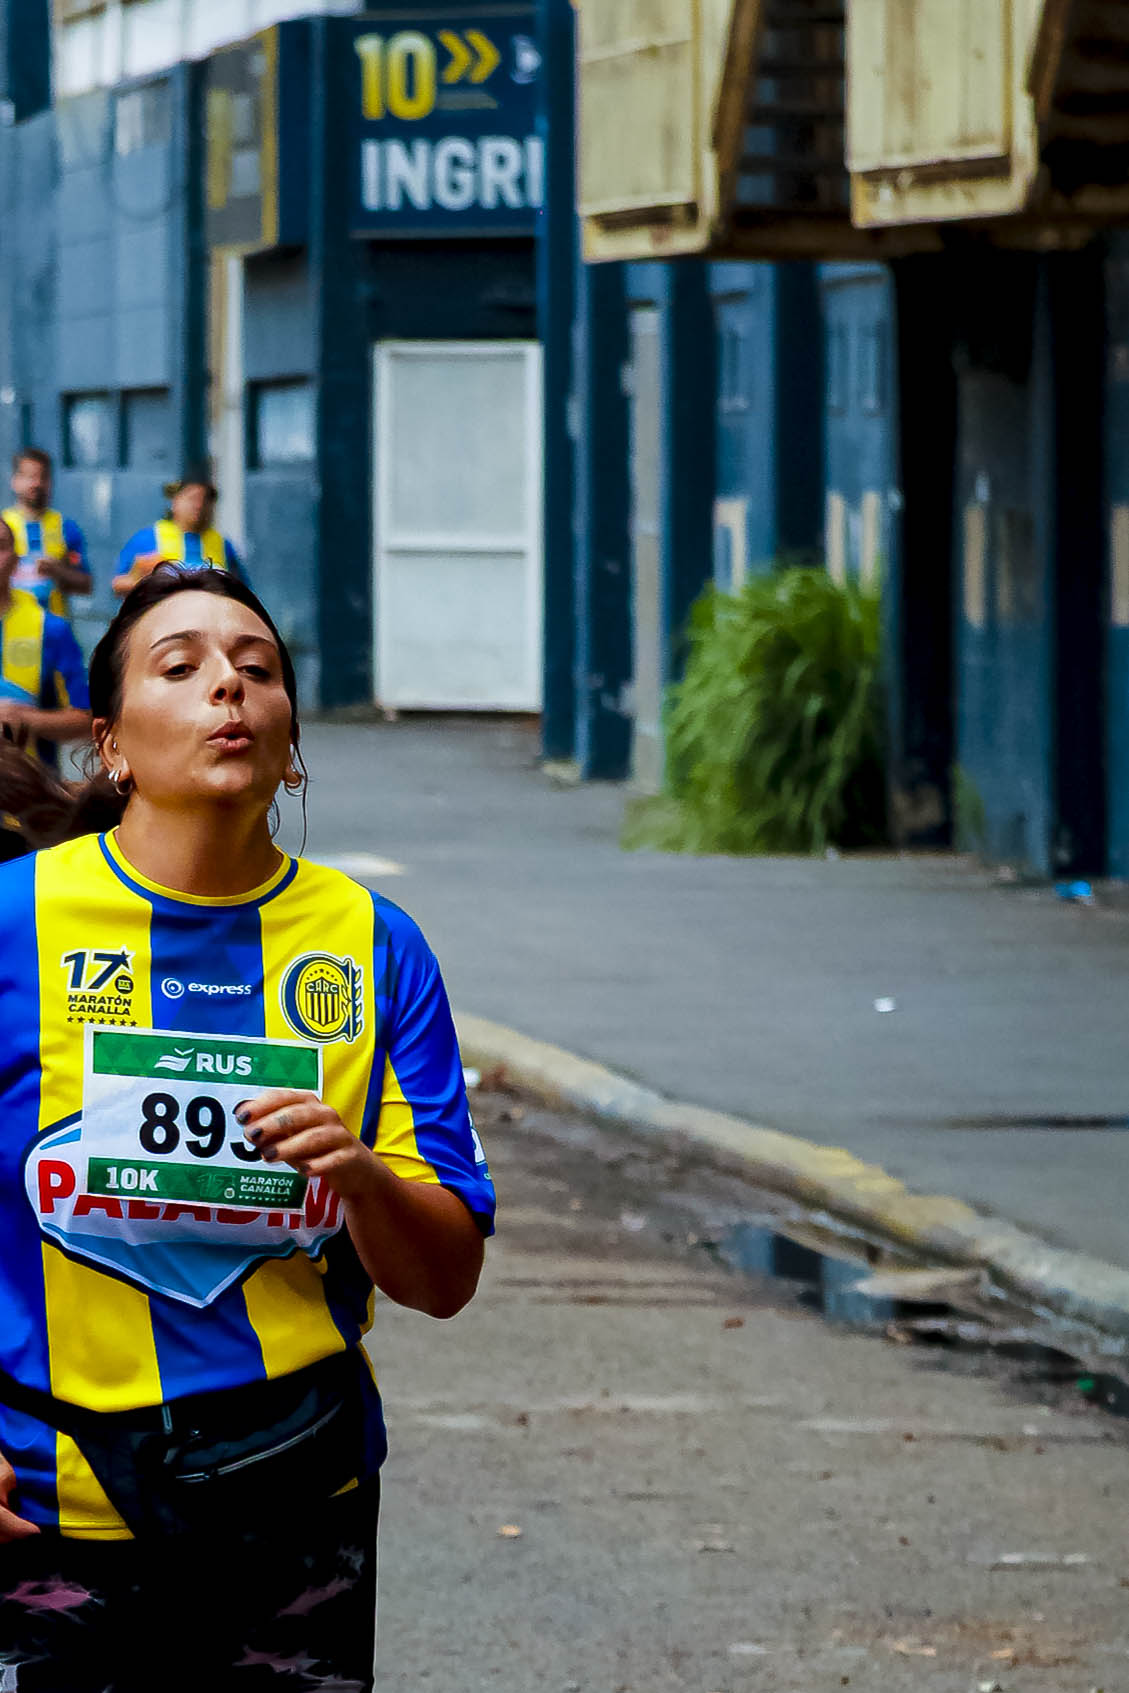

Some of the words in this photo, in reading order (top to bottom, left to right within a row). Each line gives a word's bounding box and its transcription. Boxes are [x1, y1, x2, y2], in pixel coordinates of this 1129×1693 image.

[355, 30, 437, 120] 10
[62, 950, 132, 990] 17
[188, 982, 252, 996] express
[68, 994, 132, 1007] MARATÓN
[68, 1004, 131, 1016] CANALLA
[196, 1053, 253, 1076] RUS
[106, 1166, 159, 1191] 10K
[239, 1175, 294, 1188] MARATÓN
[239, 1184, 291, 1196] CANALLA
